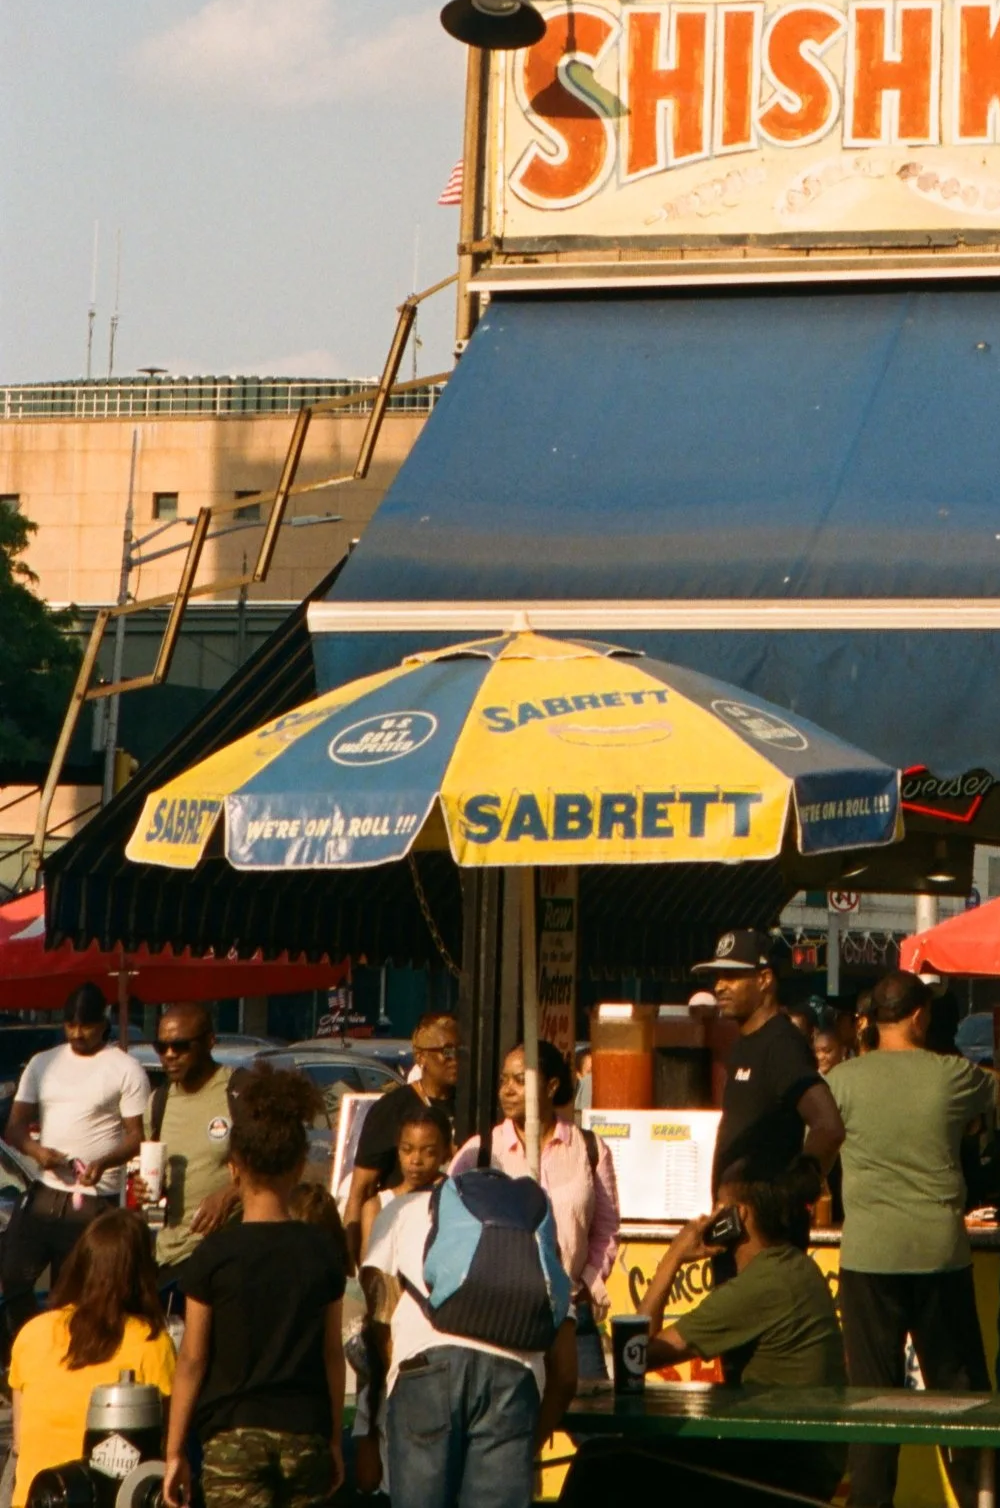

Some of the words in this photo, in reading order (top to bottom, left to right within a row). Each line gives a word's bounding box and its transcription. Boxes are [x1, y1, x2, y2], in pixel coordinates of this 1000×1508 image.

[482, 688, 669, 733] SABRETT
[461, 788, 764, 844] SABRETT
[845, 797, 870, 817] ROLL
[247, 818, 300, 840] WE'RE
[304, 818, 330, 838] ON
[332, 817, 345, 837] A
[348, 816, 390, 838] ROLL
